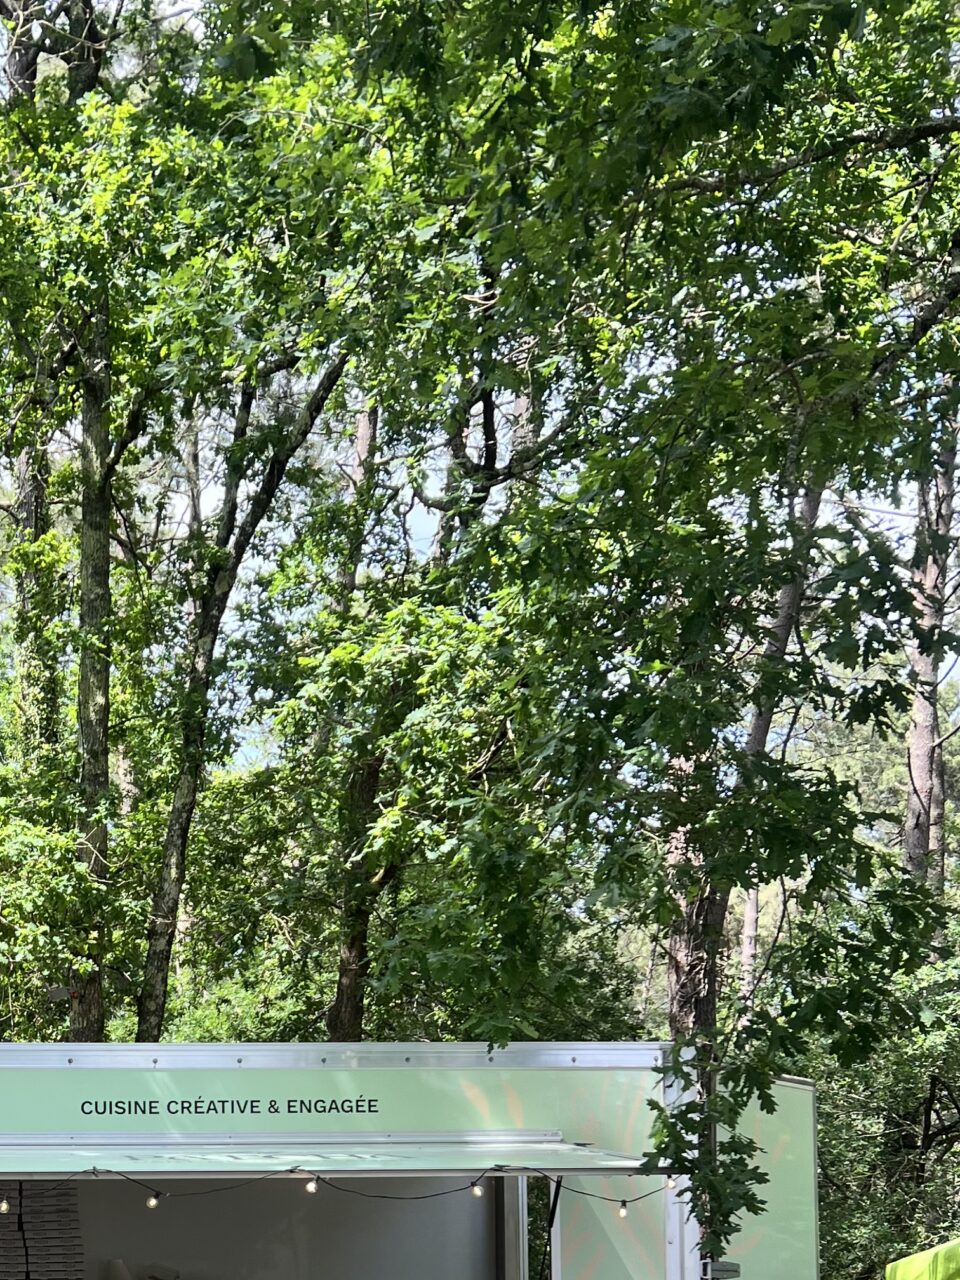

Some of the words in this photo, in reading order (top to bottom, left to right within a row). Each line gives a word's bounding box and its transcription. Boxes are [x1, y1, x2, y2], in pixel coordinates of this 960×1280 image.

[80, 1100, 160, 1115] CUISINE
[166, 1095, 261, 1114] CRÉATIVE
[267, 1099, 281, 1114] &
[286, 1094, 379, 1114] ENGAGÉE
